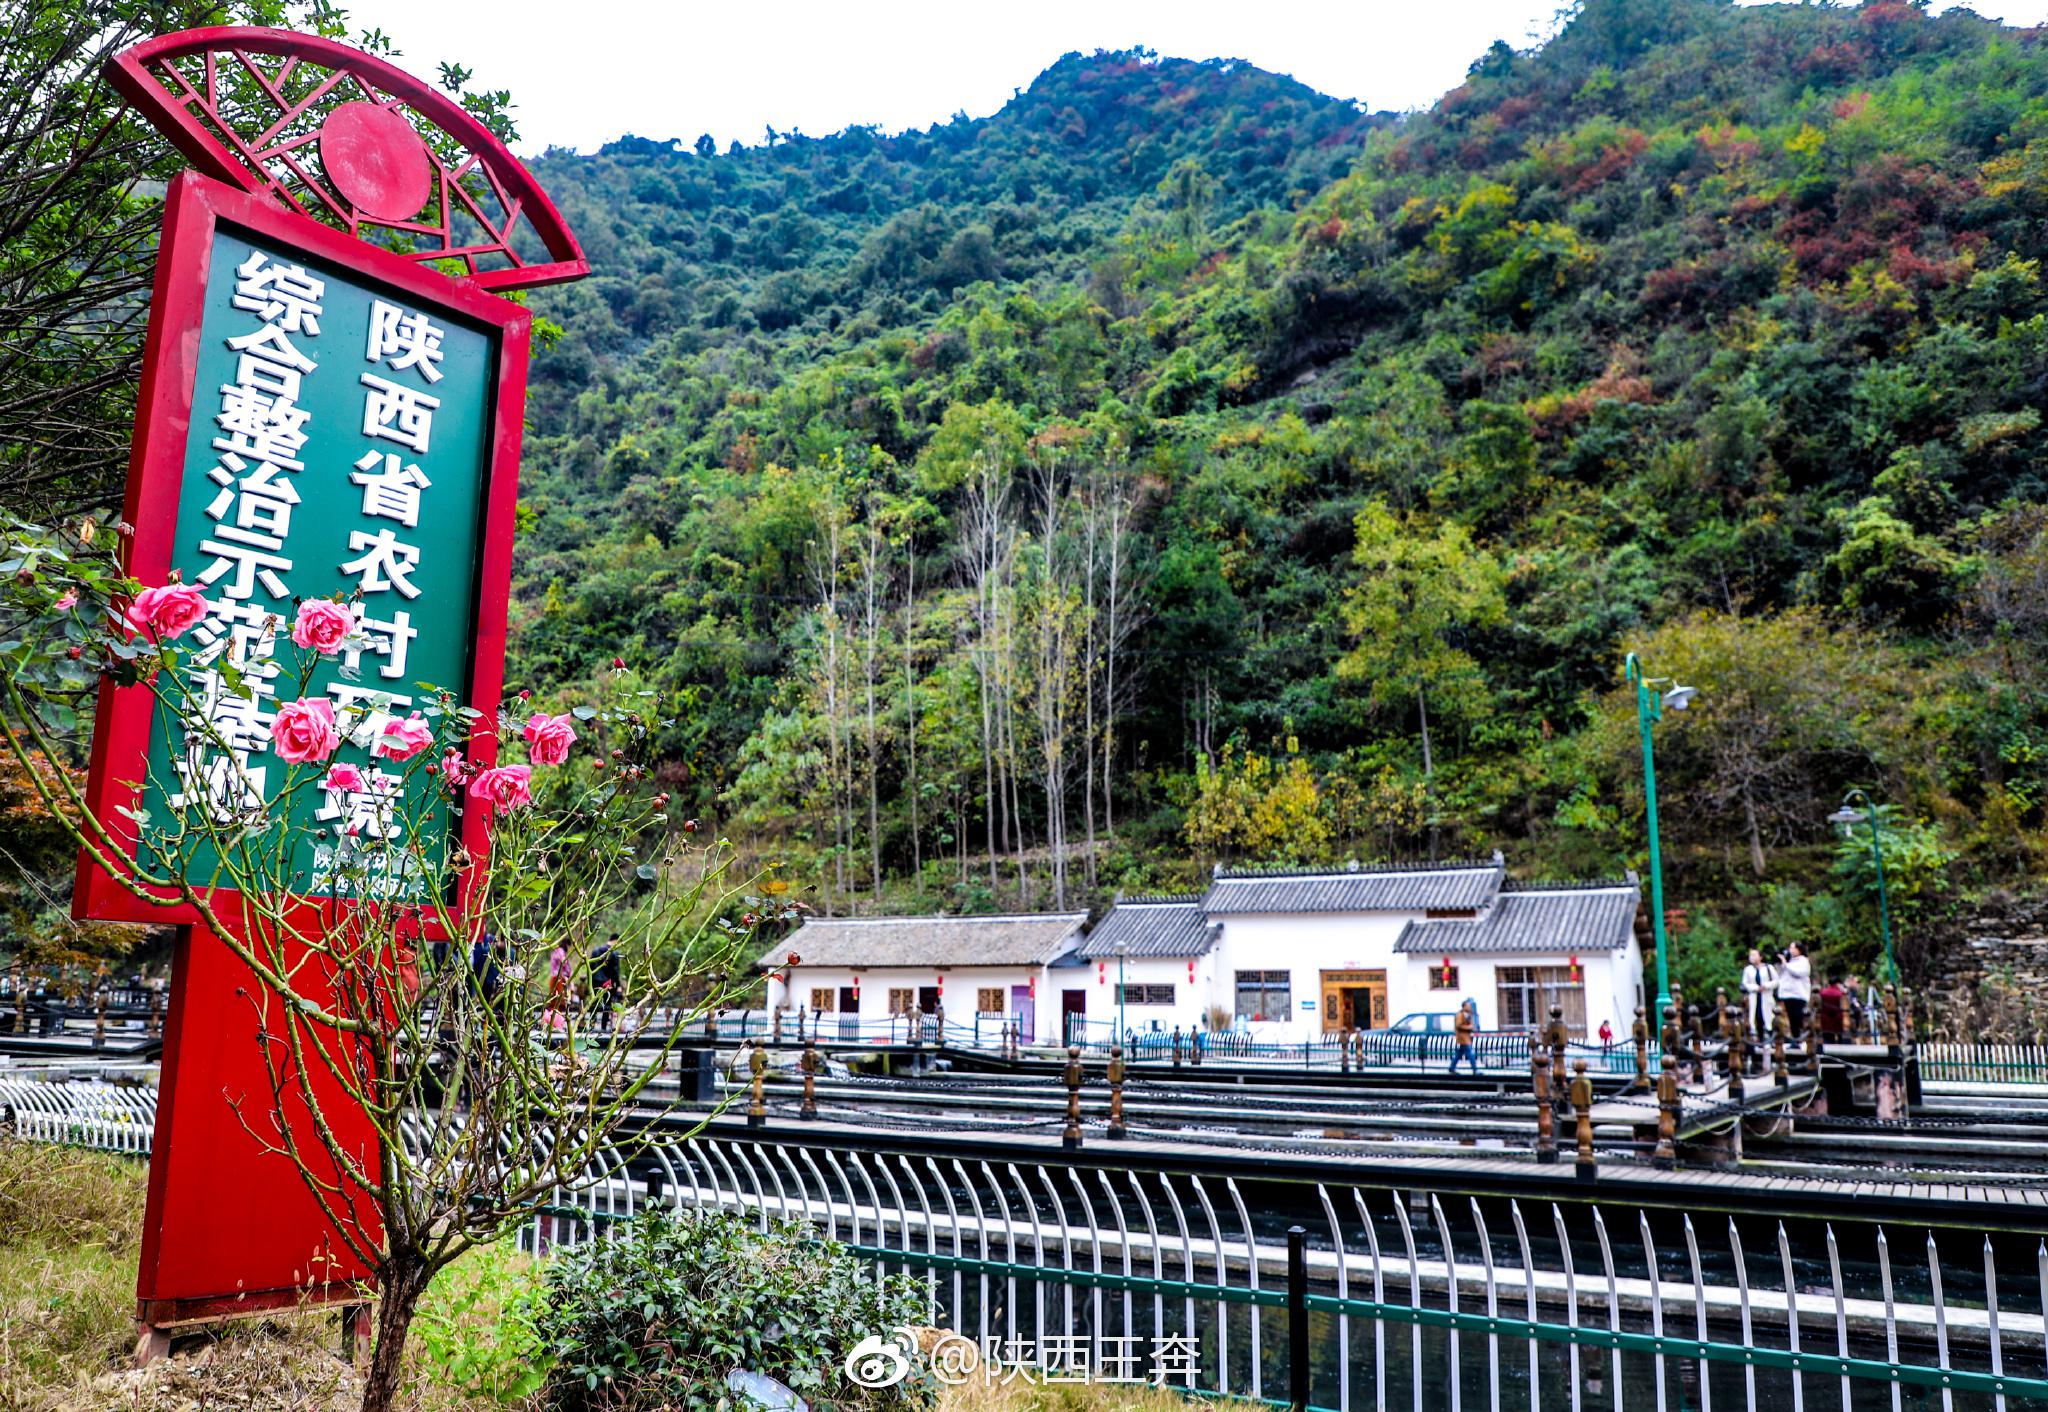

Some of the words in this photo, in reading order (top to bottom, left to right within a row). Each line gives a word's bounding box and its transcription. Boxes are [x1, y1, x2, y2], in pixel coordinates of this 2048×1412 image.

[170, 250, 325, 824] 综合整治示范基地
